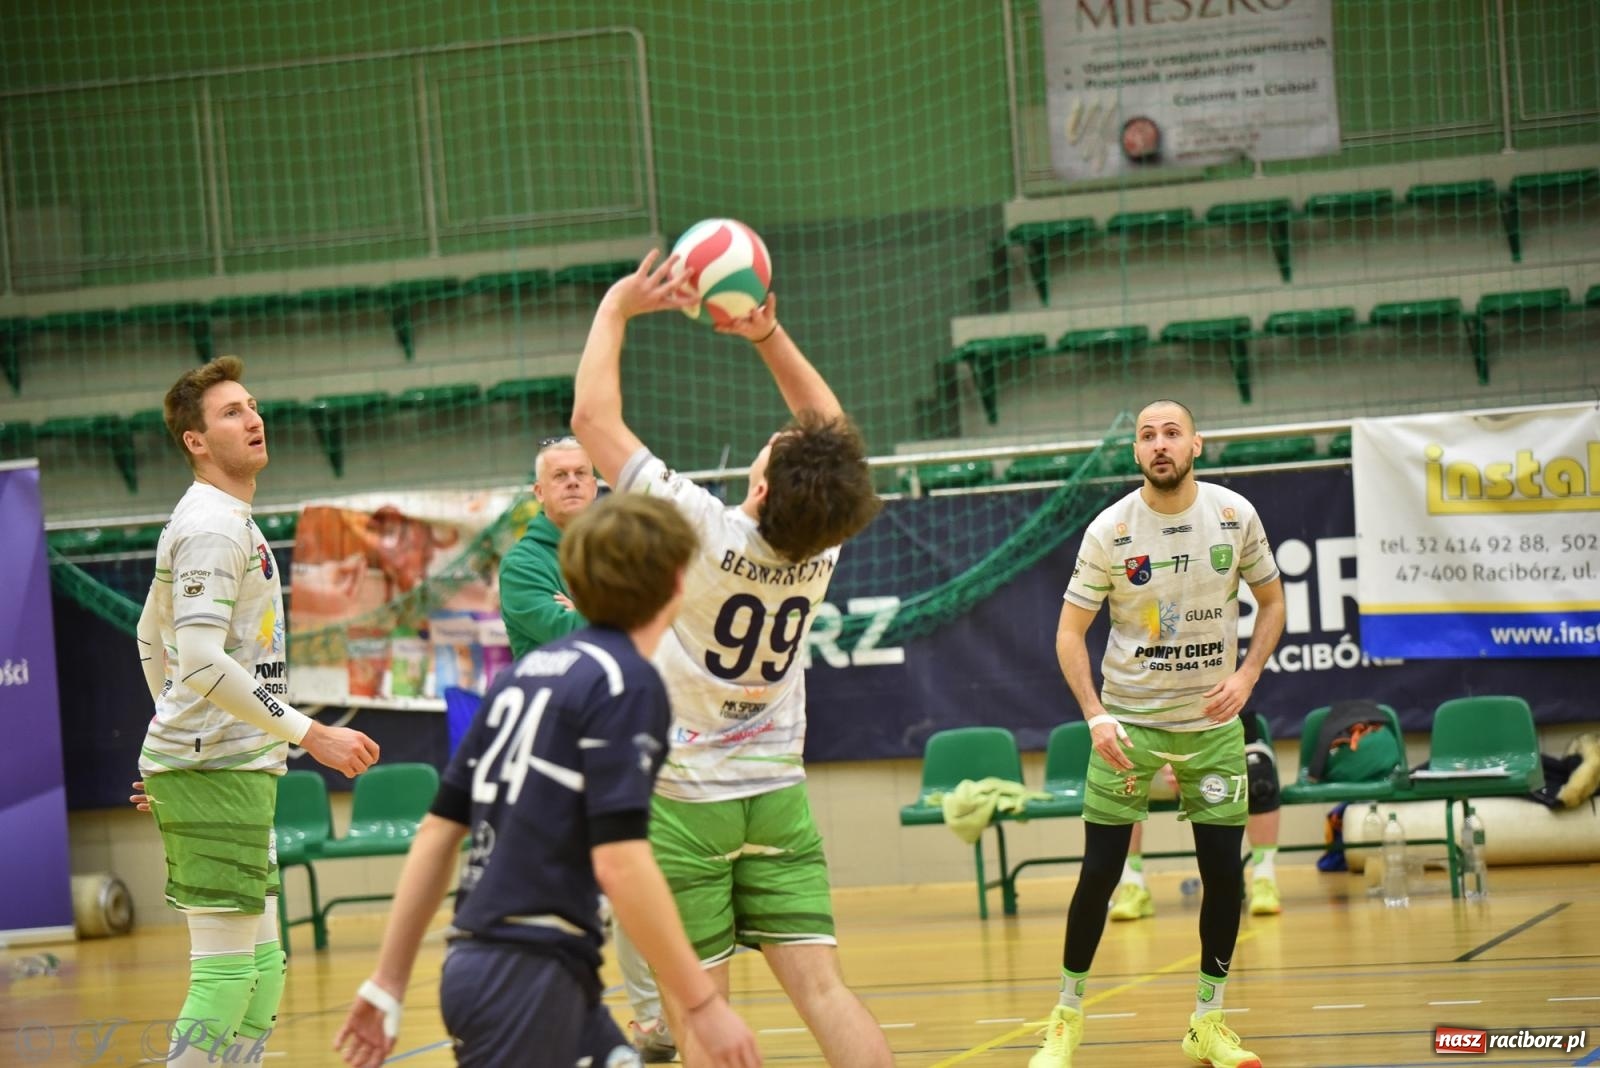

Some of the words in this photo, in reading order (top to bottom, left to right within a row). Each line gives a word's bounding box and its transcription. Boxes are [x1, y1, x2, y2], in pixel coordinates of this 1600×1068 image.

[1416, 537, 1438, 554] 32
[1444, 535, 1481, 553] 414
[1488, 534, 1512, 552] 92
[1561, 533, 1599, 552] 502
[1171, 554, 1189, 573] 77
[1395, 564, 1468, 582] 47-400
[705, 593, 811, 682] 99
[1134, 645, 1182, 660] POMPY
[254, 661, 288, 679] POMP
[1149, 662, 1172, 672] 605
[1176, 661, 1199, 671] 944
[1203, 657, 1222, 668] 146
[473, 686, 552, 805] 24
